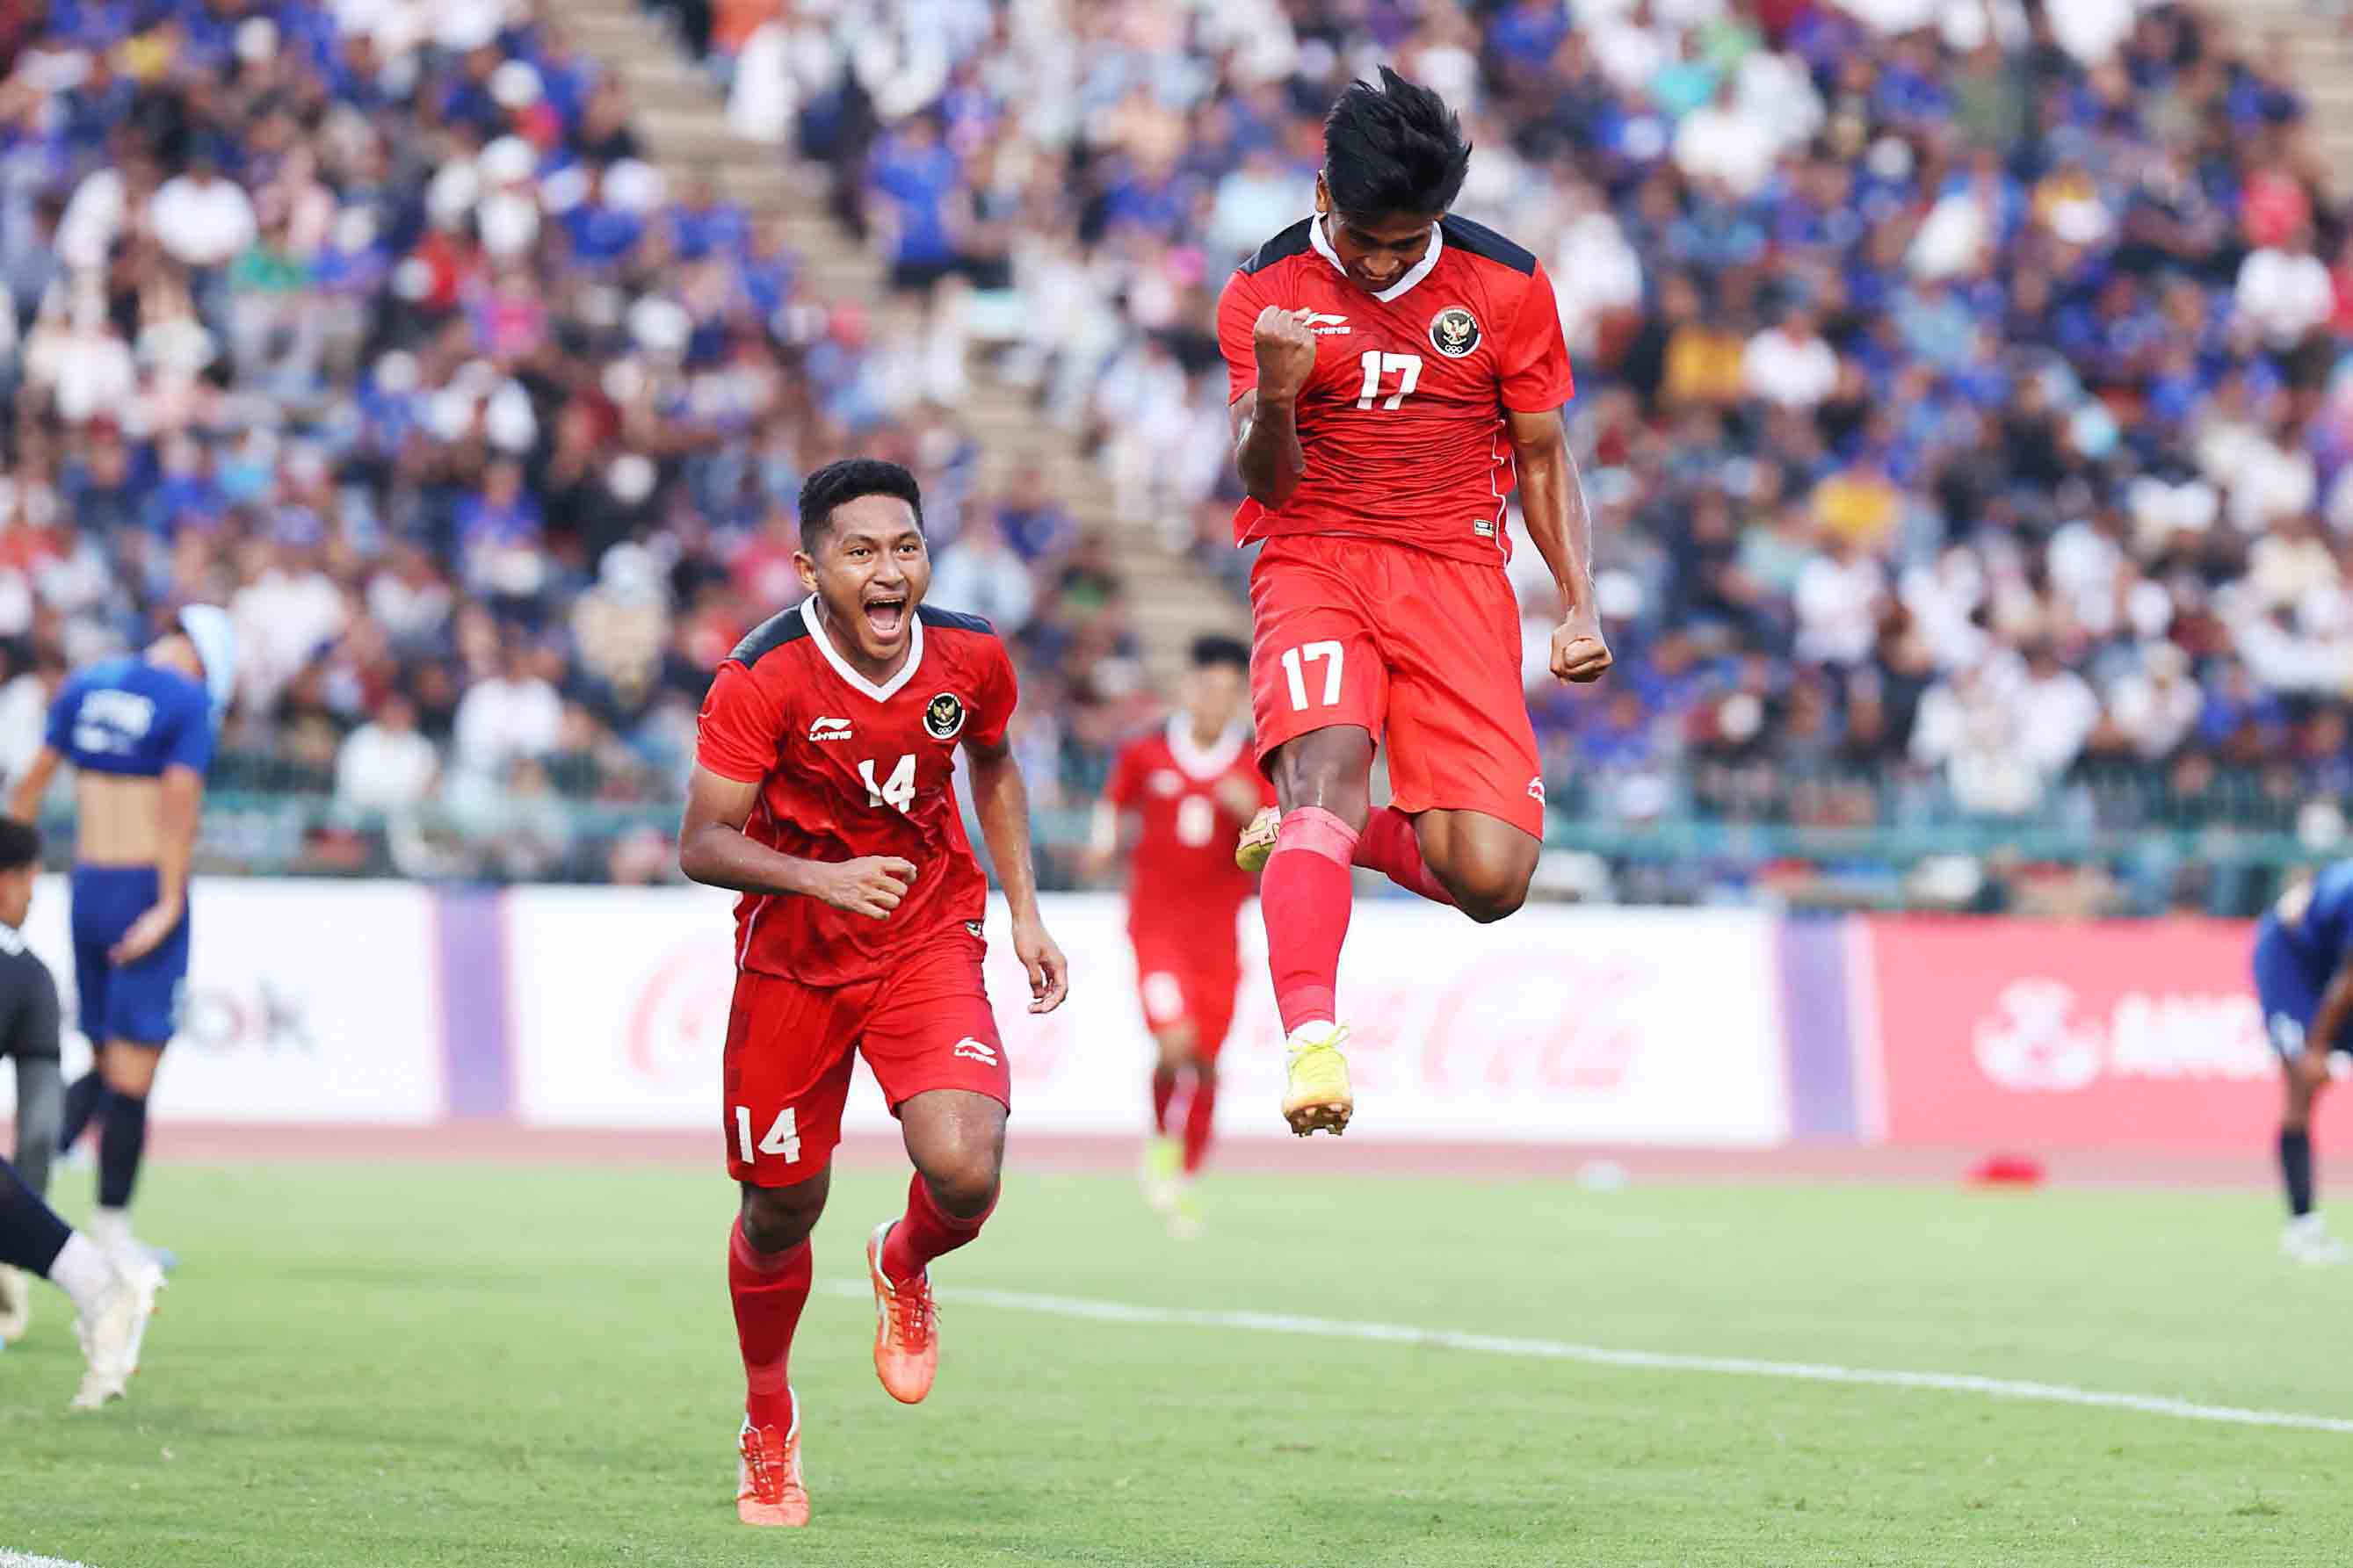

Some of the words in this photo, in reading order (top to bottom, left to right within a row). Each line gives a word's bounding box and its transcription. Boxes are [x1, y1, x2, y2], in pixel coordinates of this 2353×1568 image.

[1356, 350, 1423, 410] 17
[1281, 640, 1344, 711] 17
[858, 754, 916, 813] 14
[735, 1105, 801, 1165] 14
